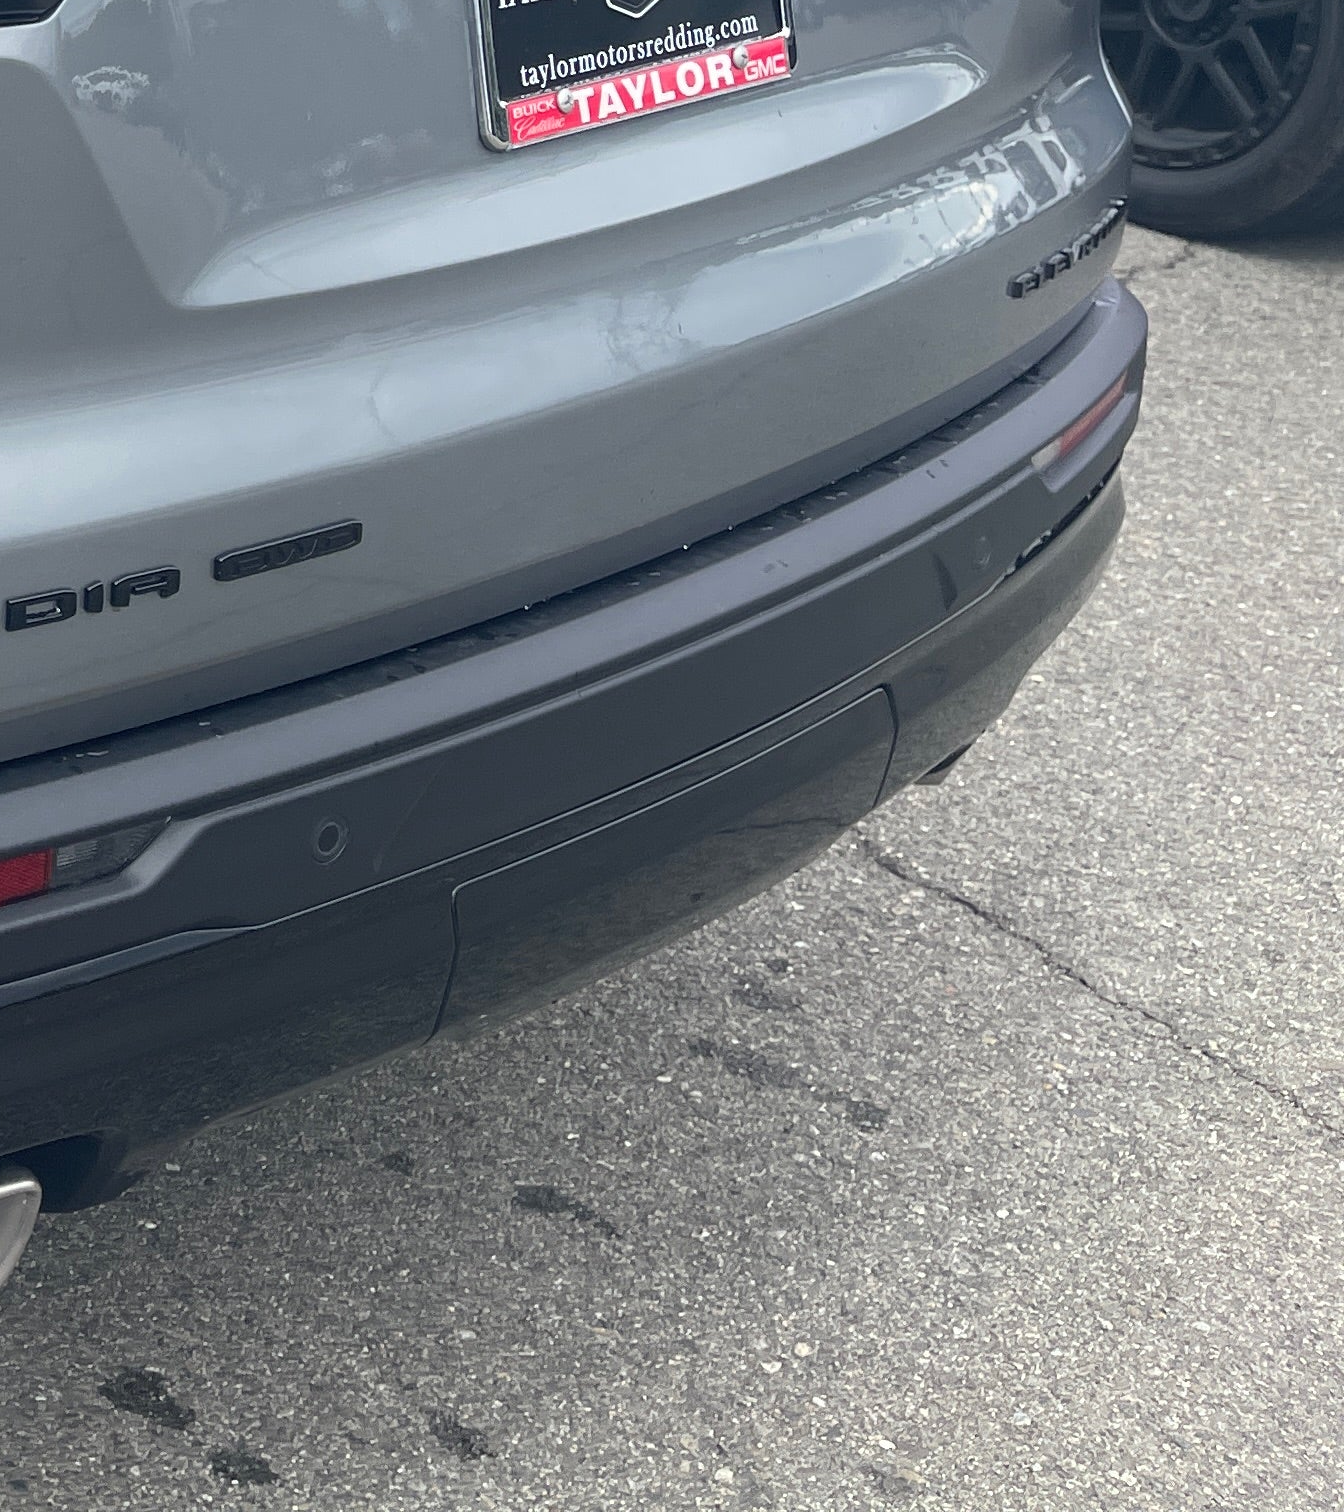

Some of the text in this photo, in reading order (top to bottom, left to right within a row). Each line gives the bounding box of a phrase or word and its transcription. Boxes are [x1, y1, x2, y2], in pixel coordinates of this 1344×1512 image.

[520, 13, 759, 88] taylormotorsredding.com
[512, 52, 787, 124] BUICK TAYLOR GMC
[514, 115, 566, 141] Cadillac
